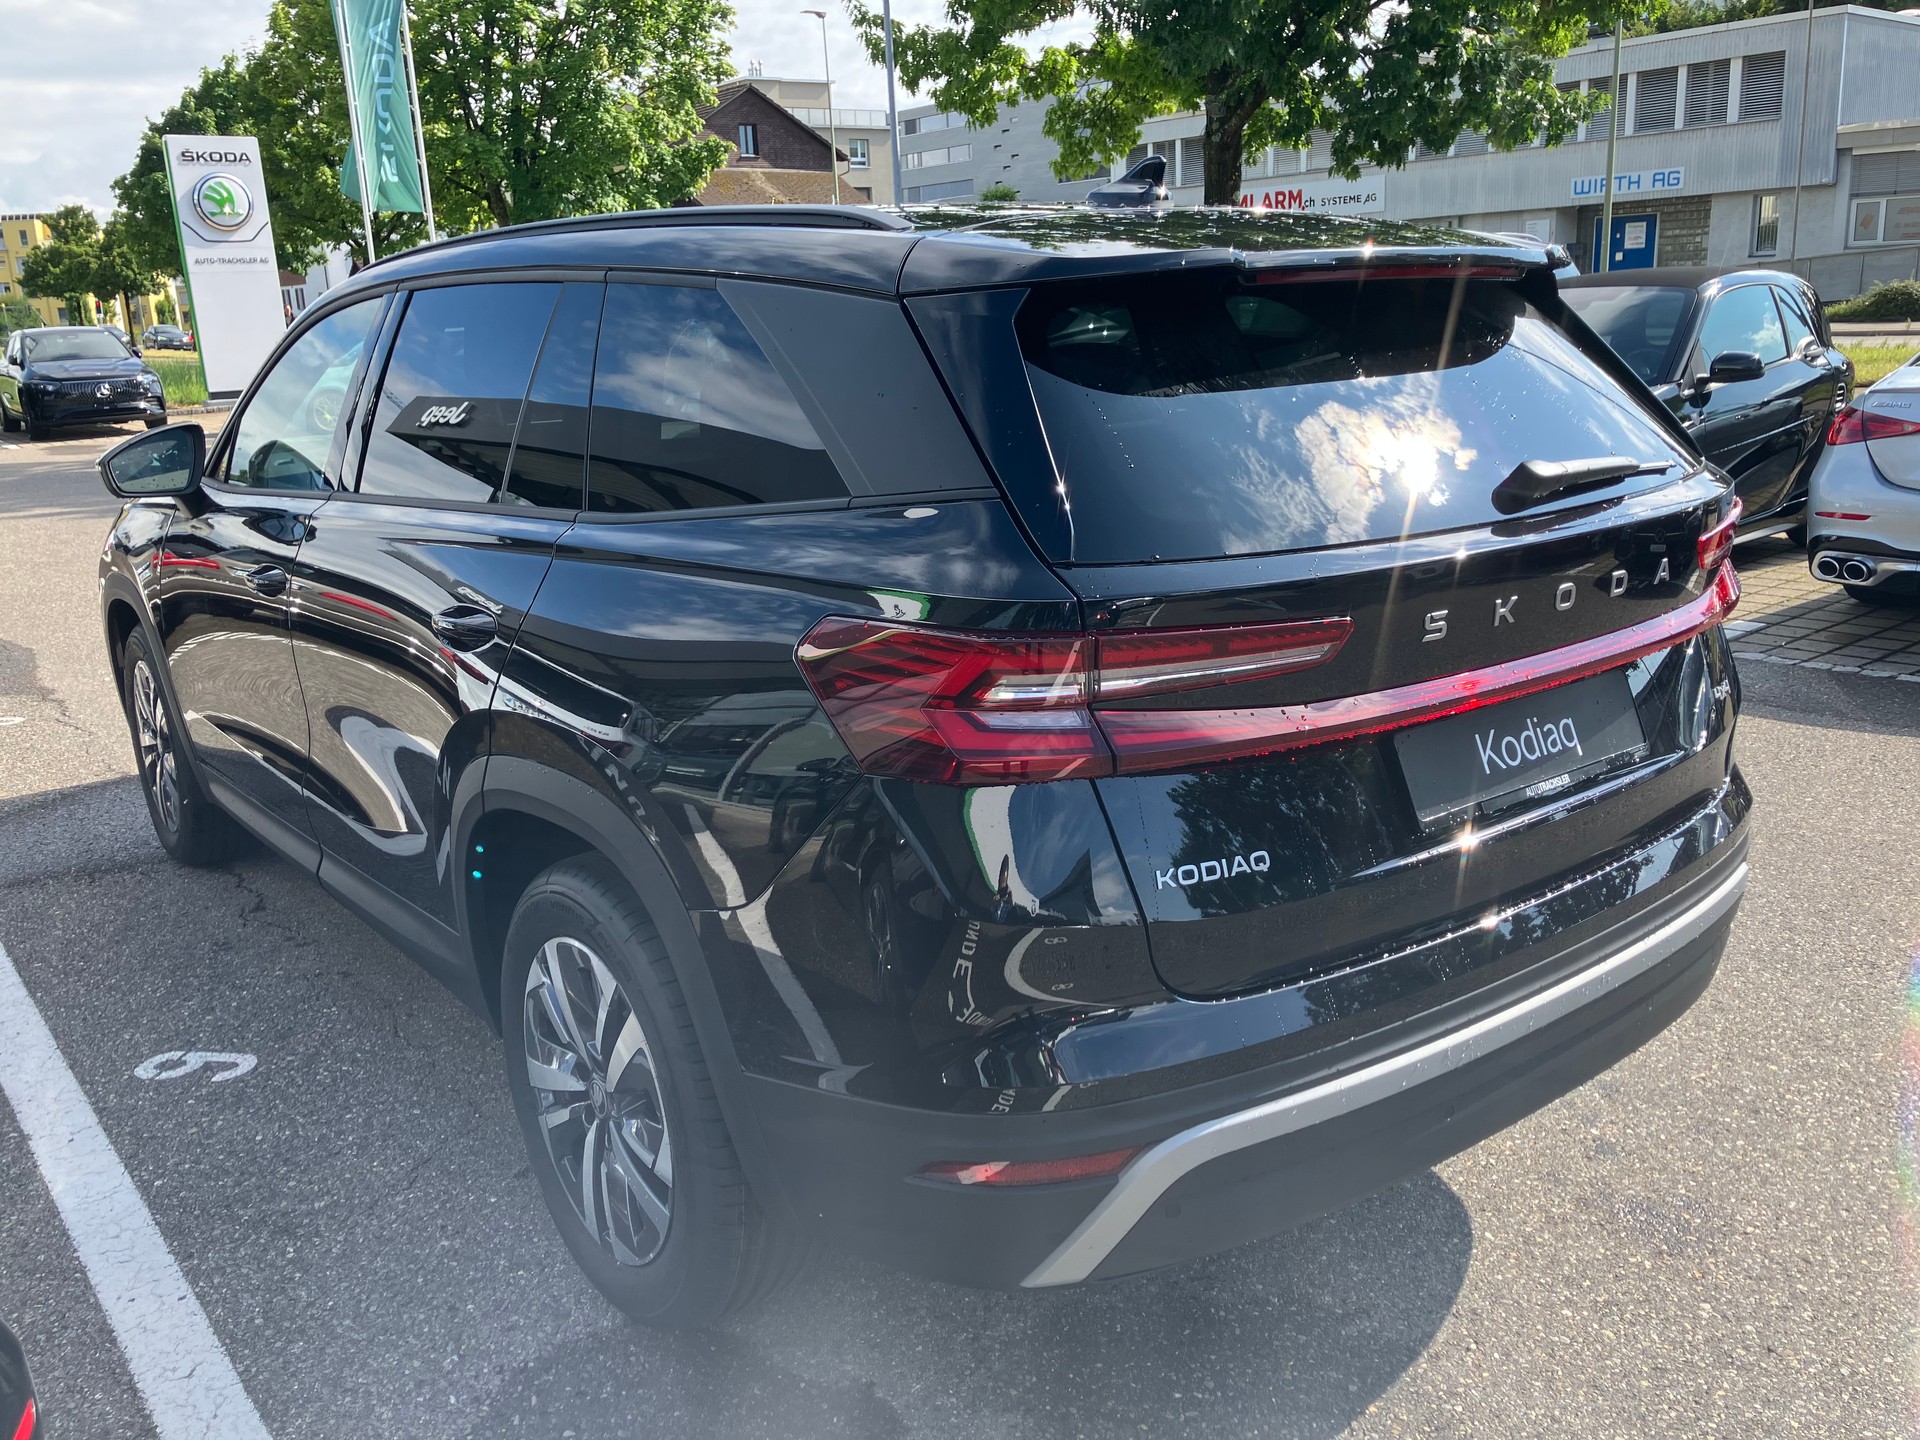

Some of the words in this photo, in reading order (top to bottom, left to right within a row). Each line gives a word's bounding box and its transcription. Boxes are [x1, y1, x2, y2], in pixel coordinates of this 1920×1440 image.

[181, 148, 252, 163] ŠKODA
[1652, 170, 1681, 188] AG
[1321, 194, 1362, 206] SYSTEME
[1363, 193, 1377, 204] AG
[1474, 716, 1583, 775] Kodiaq
[1156, 850, 1271, 890] KODIAQ
